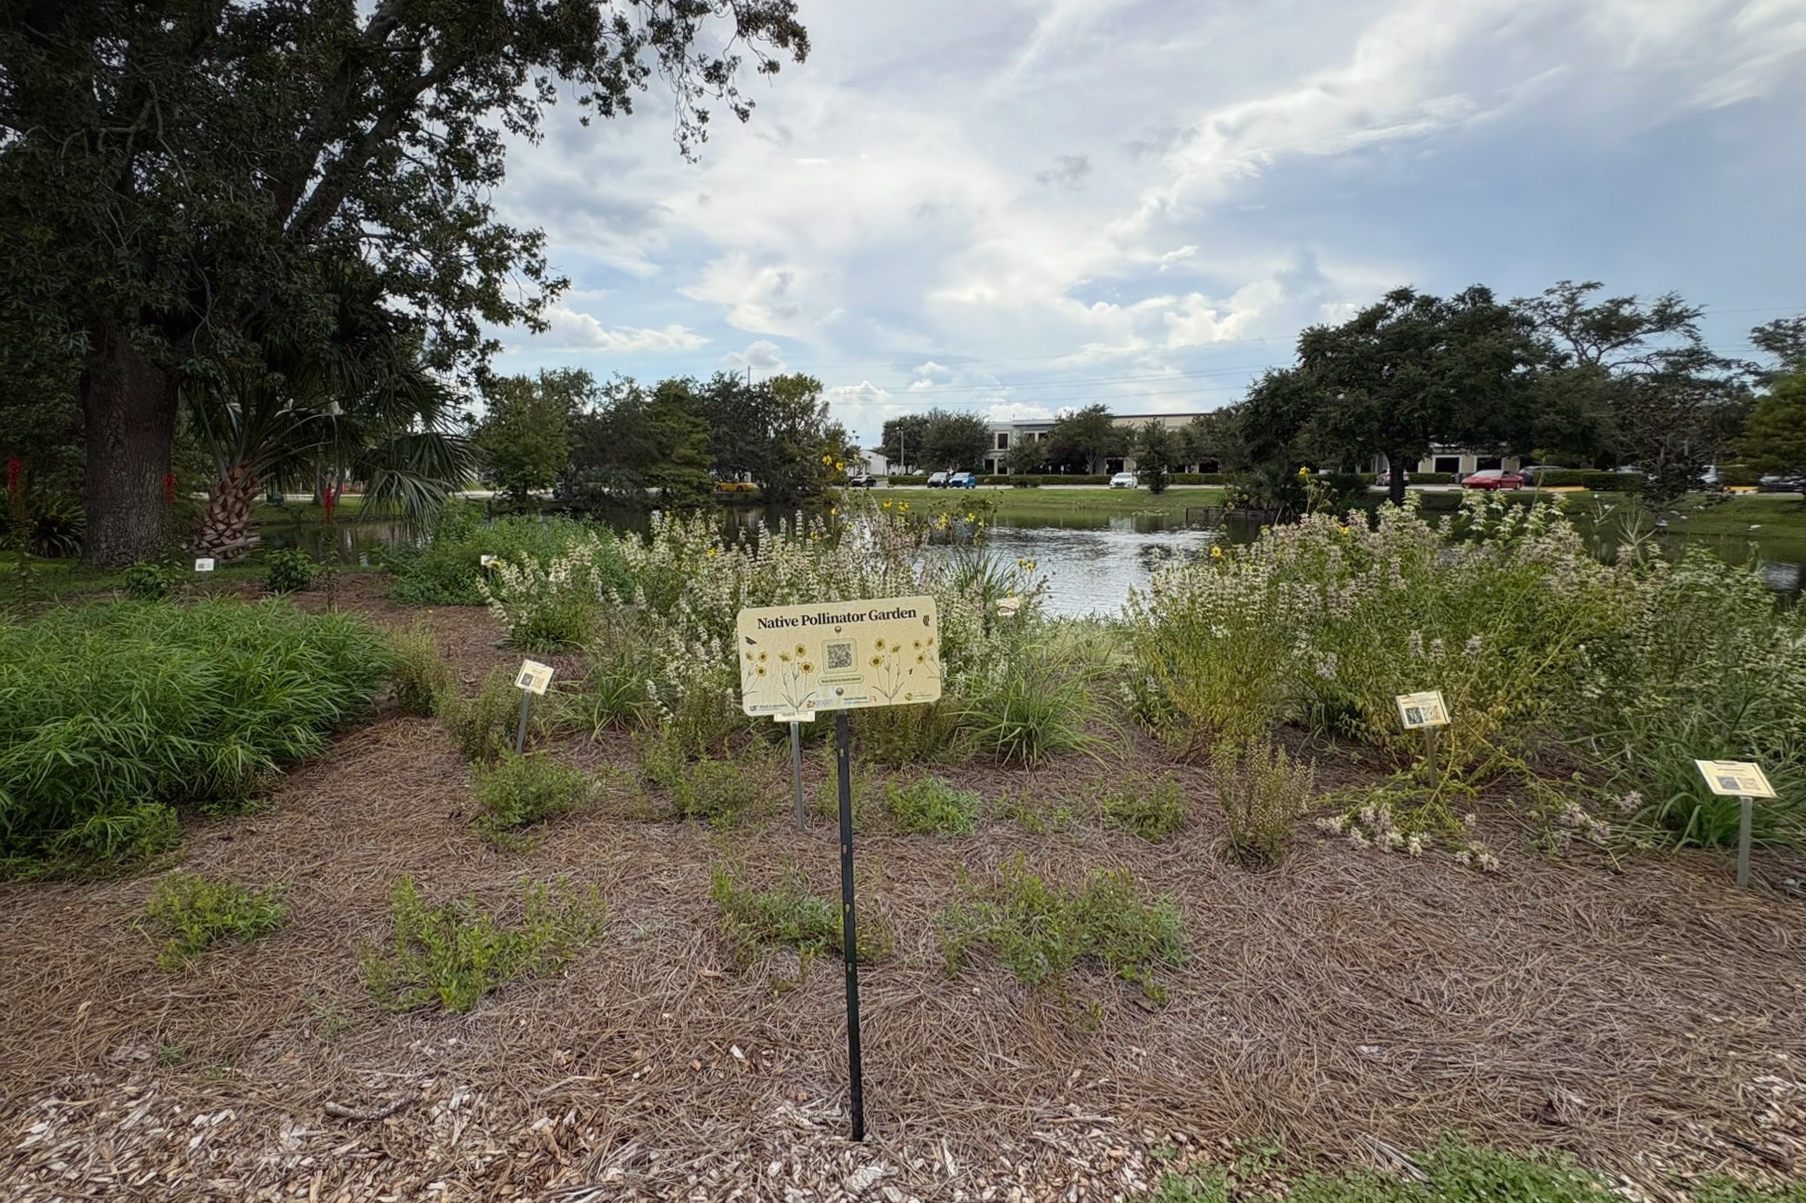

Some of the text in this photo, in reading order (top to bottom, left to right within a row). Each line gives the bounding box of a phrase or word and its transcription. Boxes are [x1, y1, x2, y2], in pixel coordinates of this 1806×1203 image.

[757, 607, 917, 630] Native Pollinator Garden
